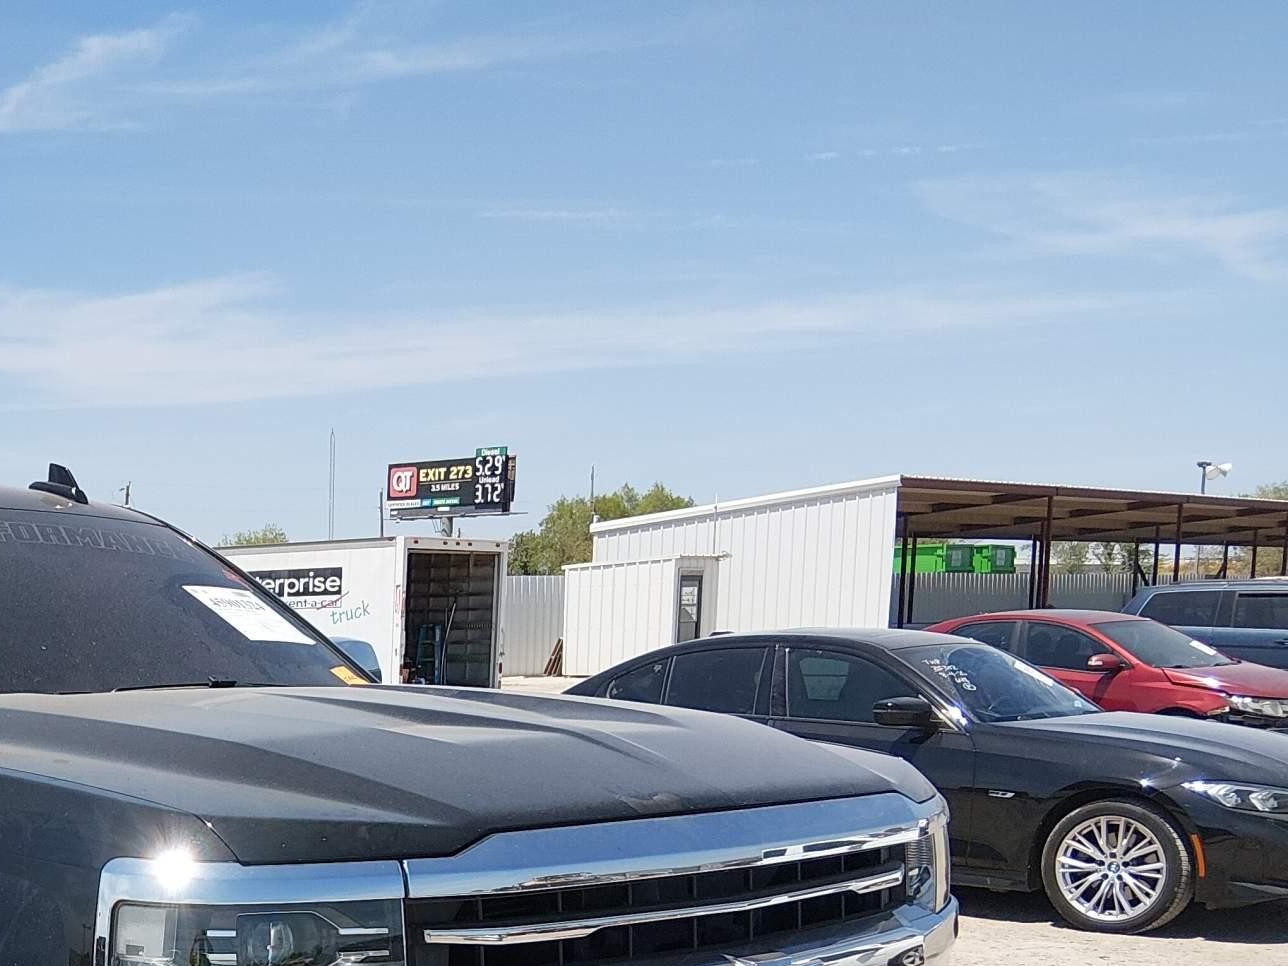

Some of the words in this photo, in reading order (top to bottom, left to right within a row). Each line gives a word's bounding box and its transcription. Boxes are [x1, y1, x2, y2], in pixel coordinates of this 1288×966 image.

[481, 448, 500, 456] Diesel
[392, 471, 413, 493] QT
[419, 468, 447, 481] EXIT
[449, 466, 472, 480] 273
[329, 600, 370, 625] truck
